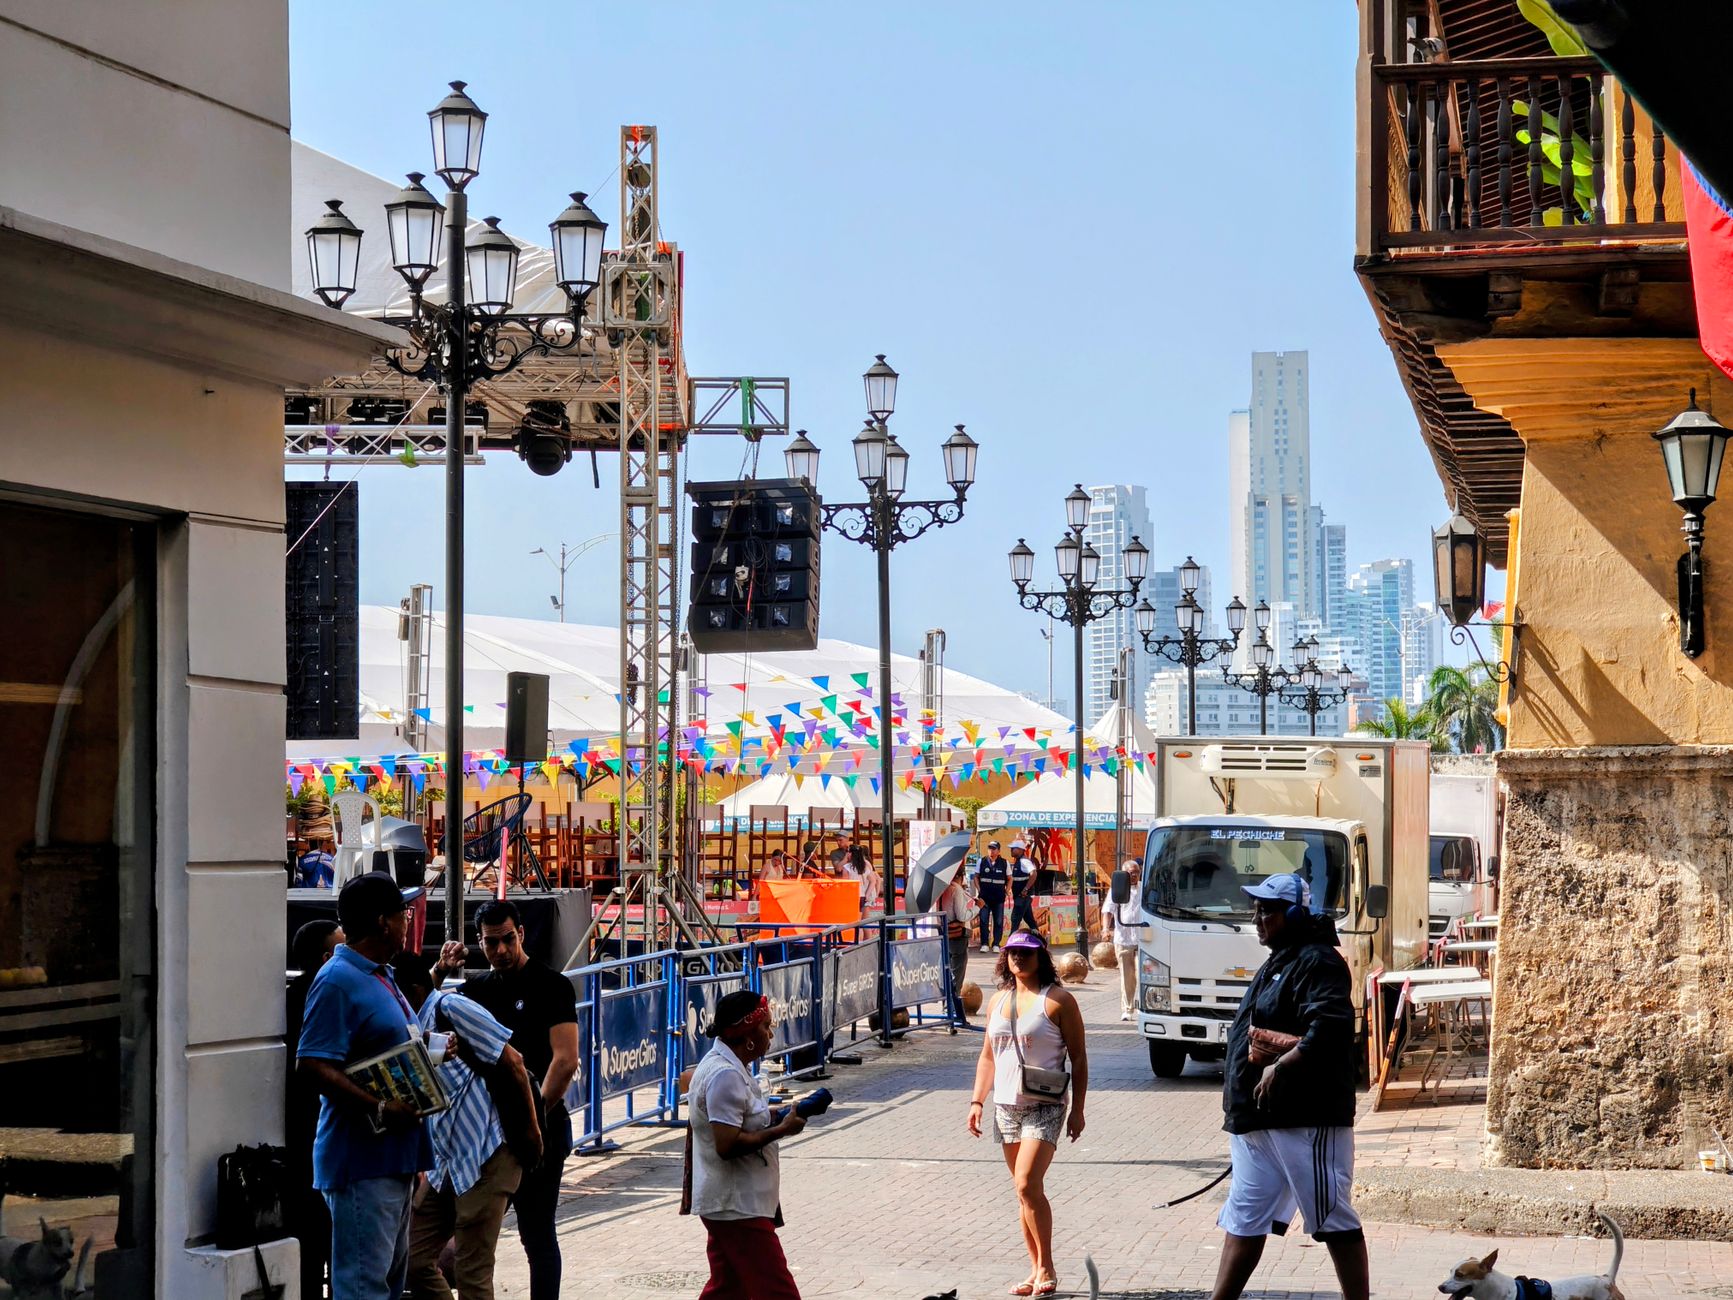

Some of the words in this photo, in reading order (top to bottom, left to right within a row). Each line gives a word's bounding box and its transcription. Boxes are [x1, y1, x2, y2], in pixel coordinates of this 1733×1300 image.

[1009, 812, 1037, 821] ZONA
[1038, 812, 1052, 821] DE
[1211, 830, 1226, 839] EL
[1227, 830, 1285, 840] PECHICHE
[901, 961, 939, 990] SuperGiros
[609, 1037, 657, 1079] SuperGiros
